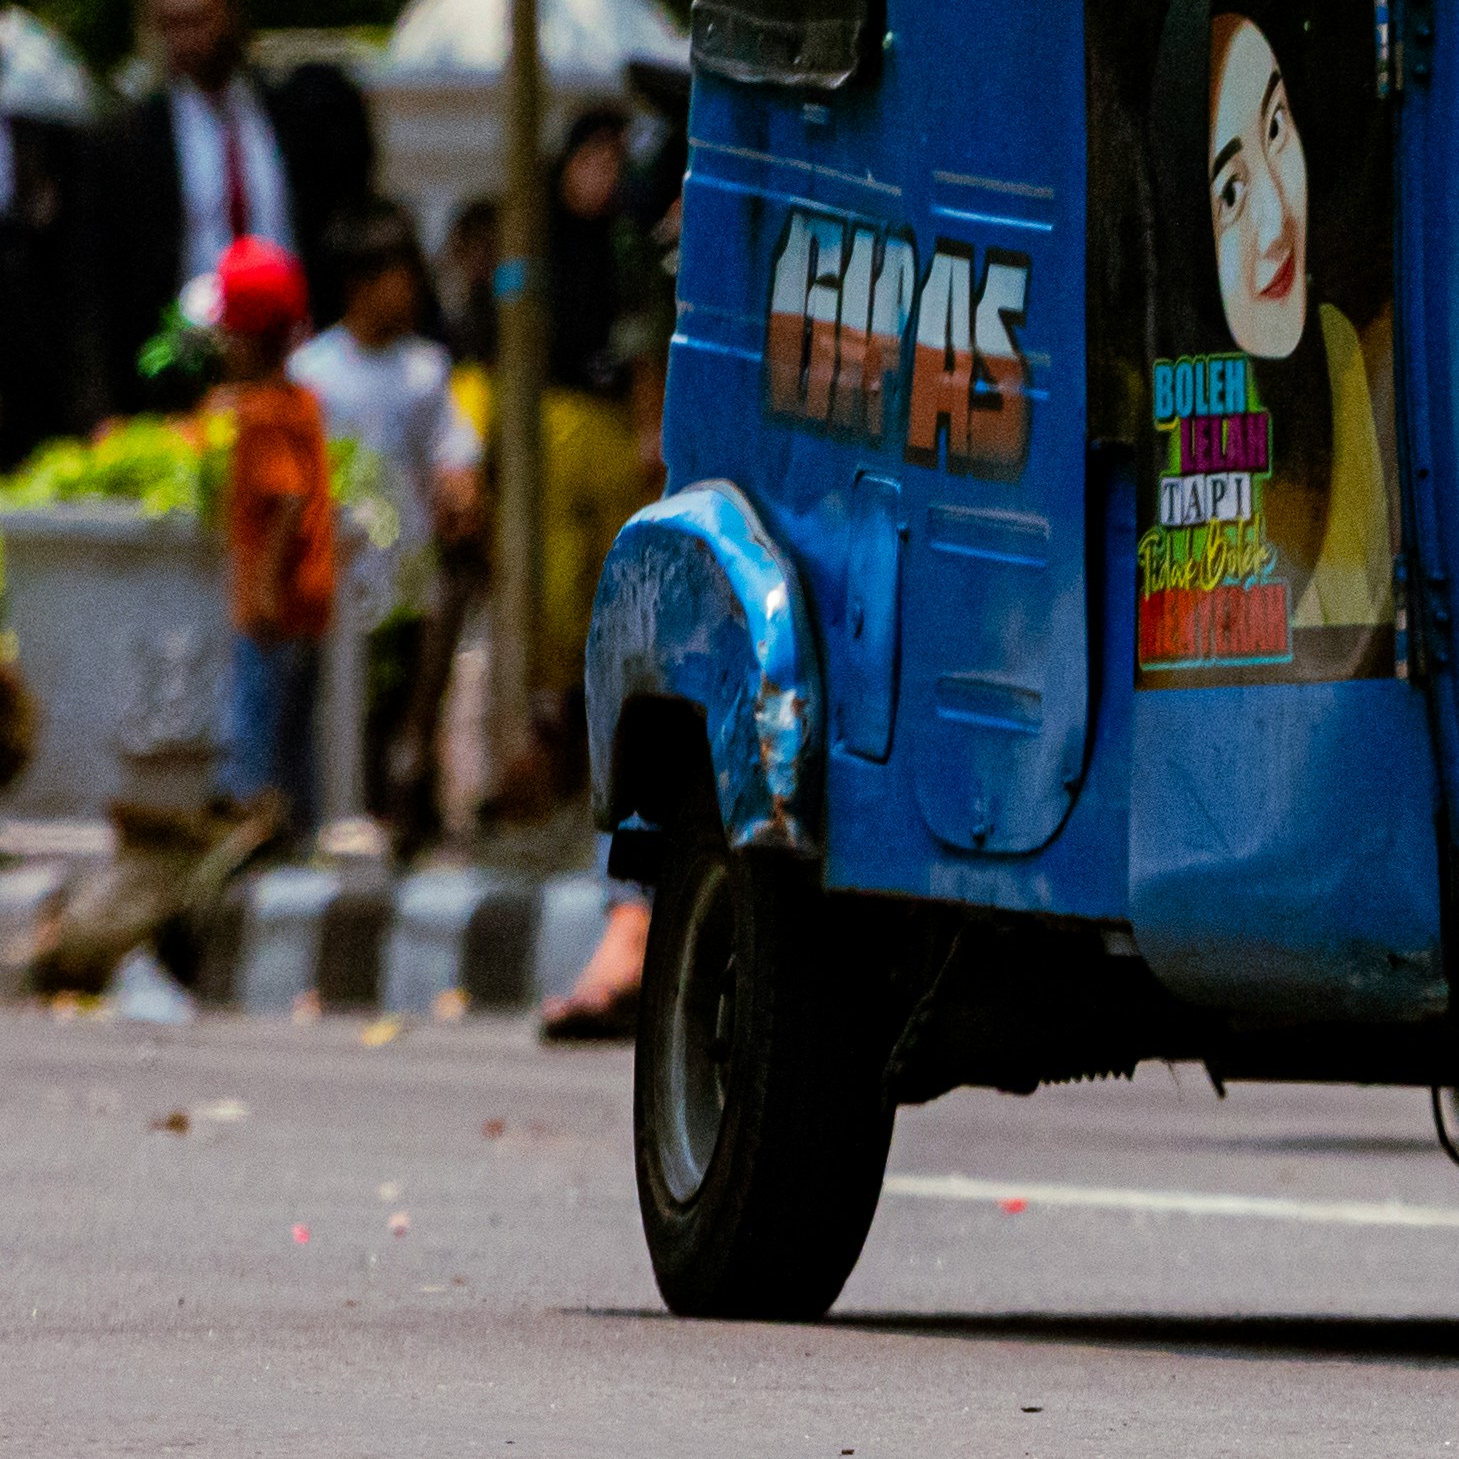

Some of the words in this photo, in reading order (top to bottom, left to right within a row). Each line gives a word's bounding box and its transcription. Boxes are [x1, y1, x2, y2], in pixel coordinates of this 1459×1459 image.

[1154, 357, 1249, 420] BOLEH
[1180, 412, 1269, 473] LELAH
[1162, 476, 1247, 524] TAPI
